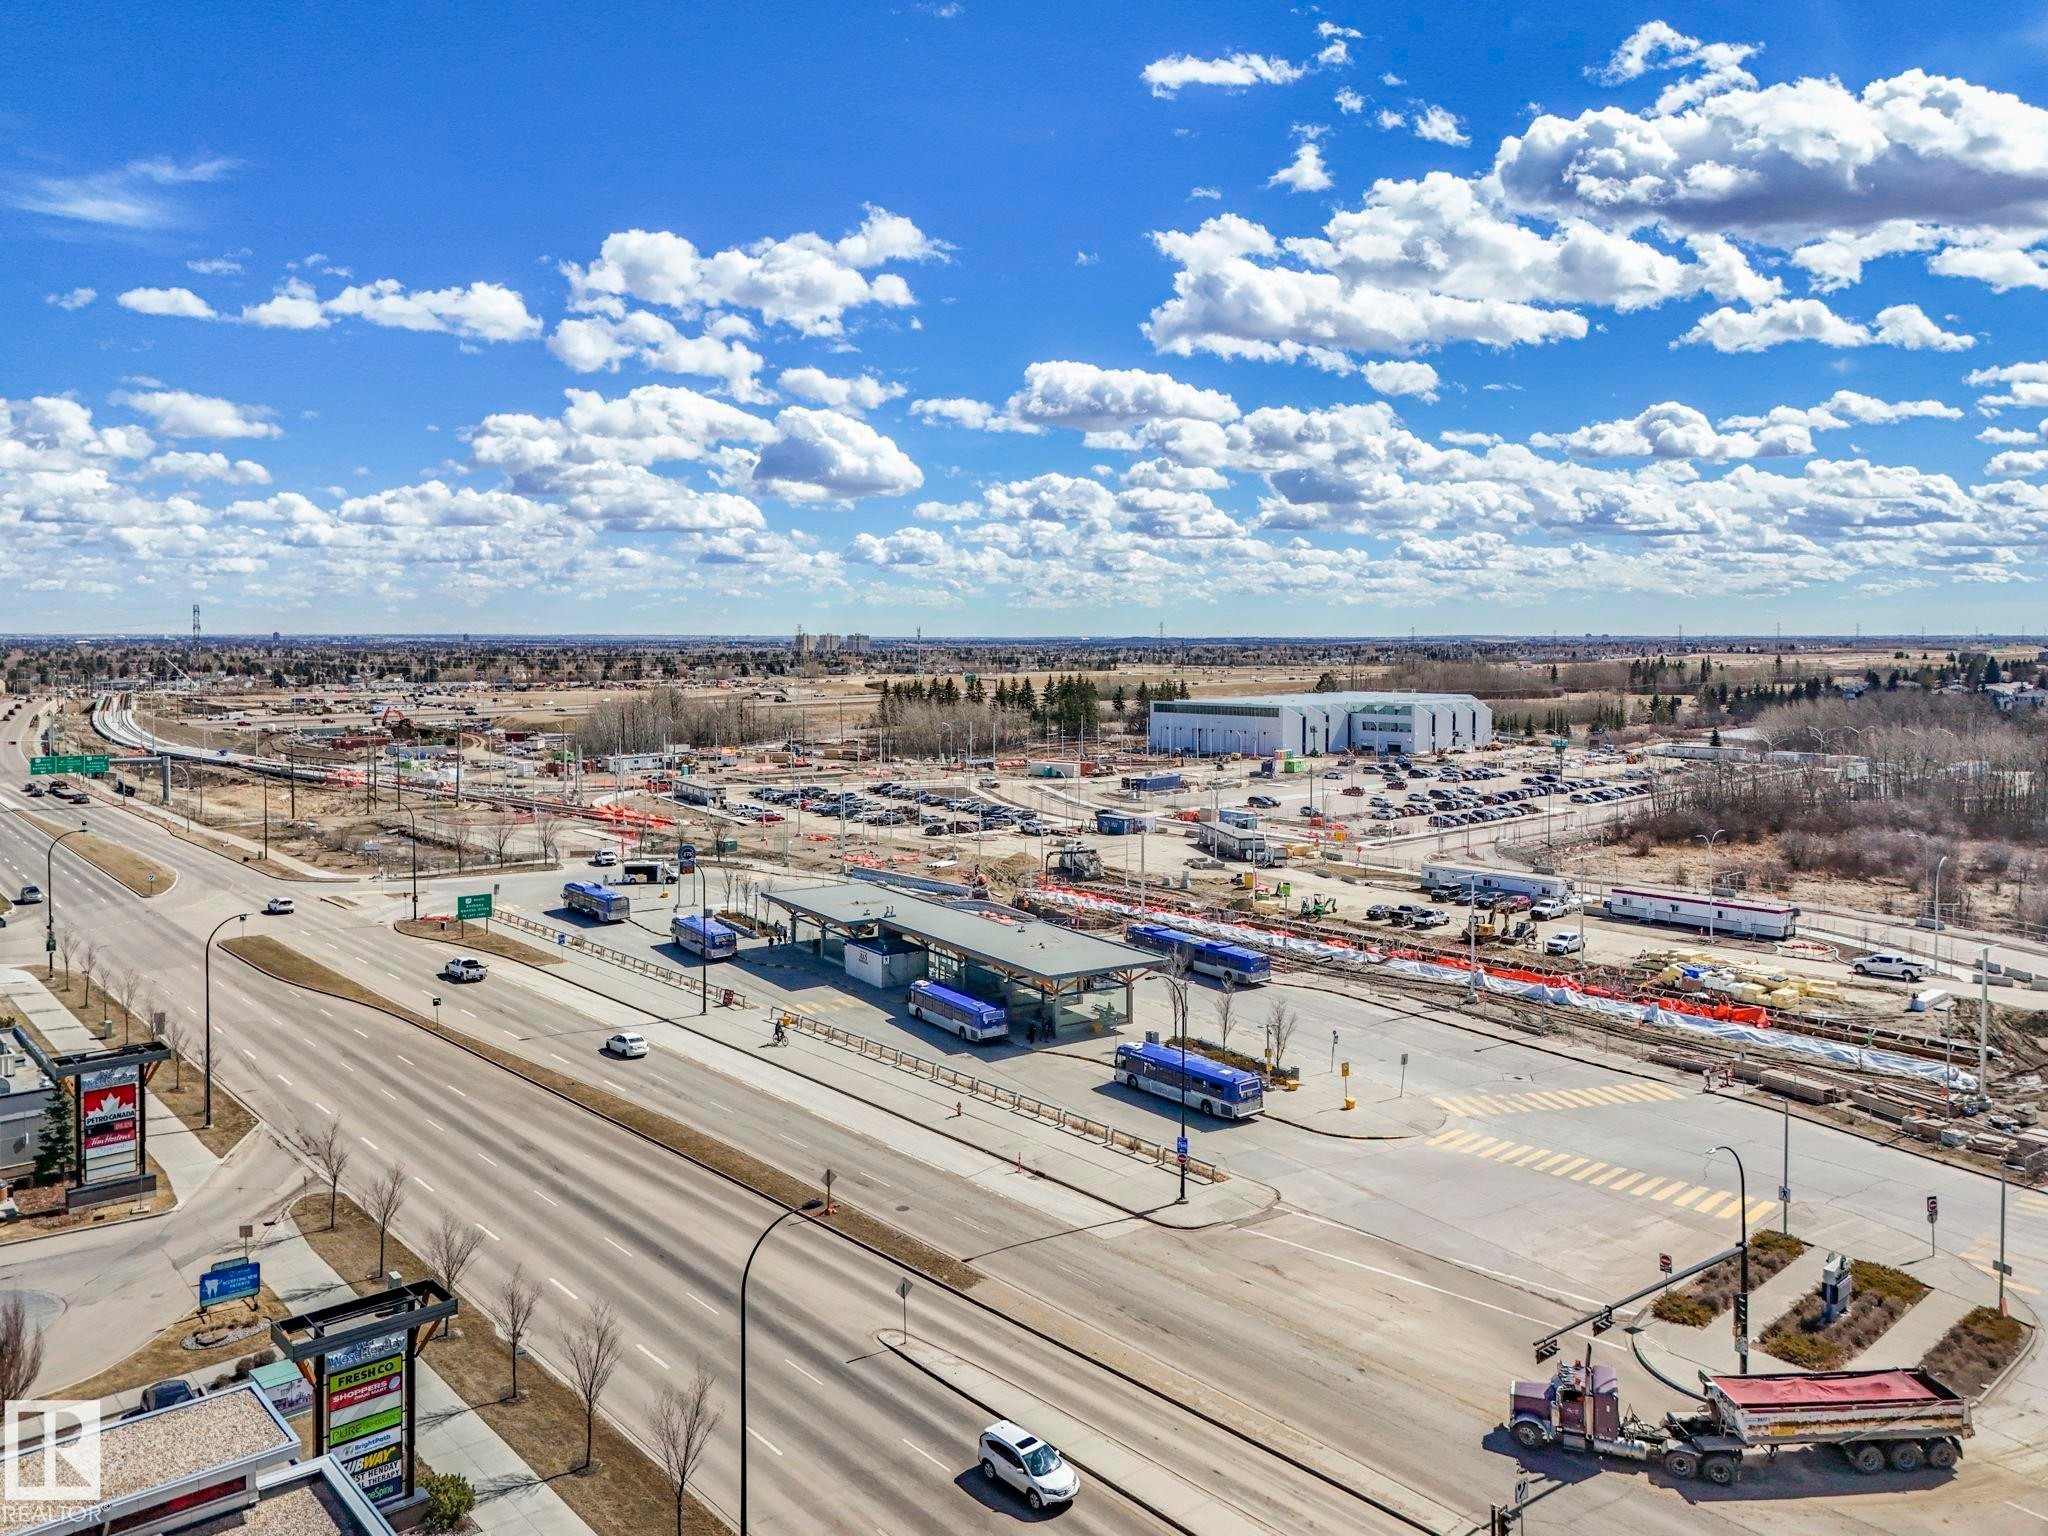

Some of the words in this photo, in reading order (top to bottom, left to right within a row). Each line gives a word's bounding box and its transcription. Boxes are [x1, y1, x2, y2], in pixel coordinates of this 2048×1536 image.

[91, 1137, 104, 1146] Tim
[105, 1134, 130, 1142] Hortons
[222, 1277, 247, 1285] ACCEPTING
[328, 1352, 360, 1369] West
[360, 1336, 406, 1360] Henday
[332, 1380, 388, 1403] SHOPPERS
[354, 1392, 371, 1400] DRUG
[332, 1424, 362, 1441] PURE
[354, 1434, 391, 1450] BrightPath
[368, 1461, 399, 1478] HENDAY
[368, 1469, 400, 1485] THERAPY
[367, 1484, 394, 1499] neSpine
